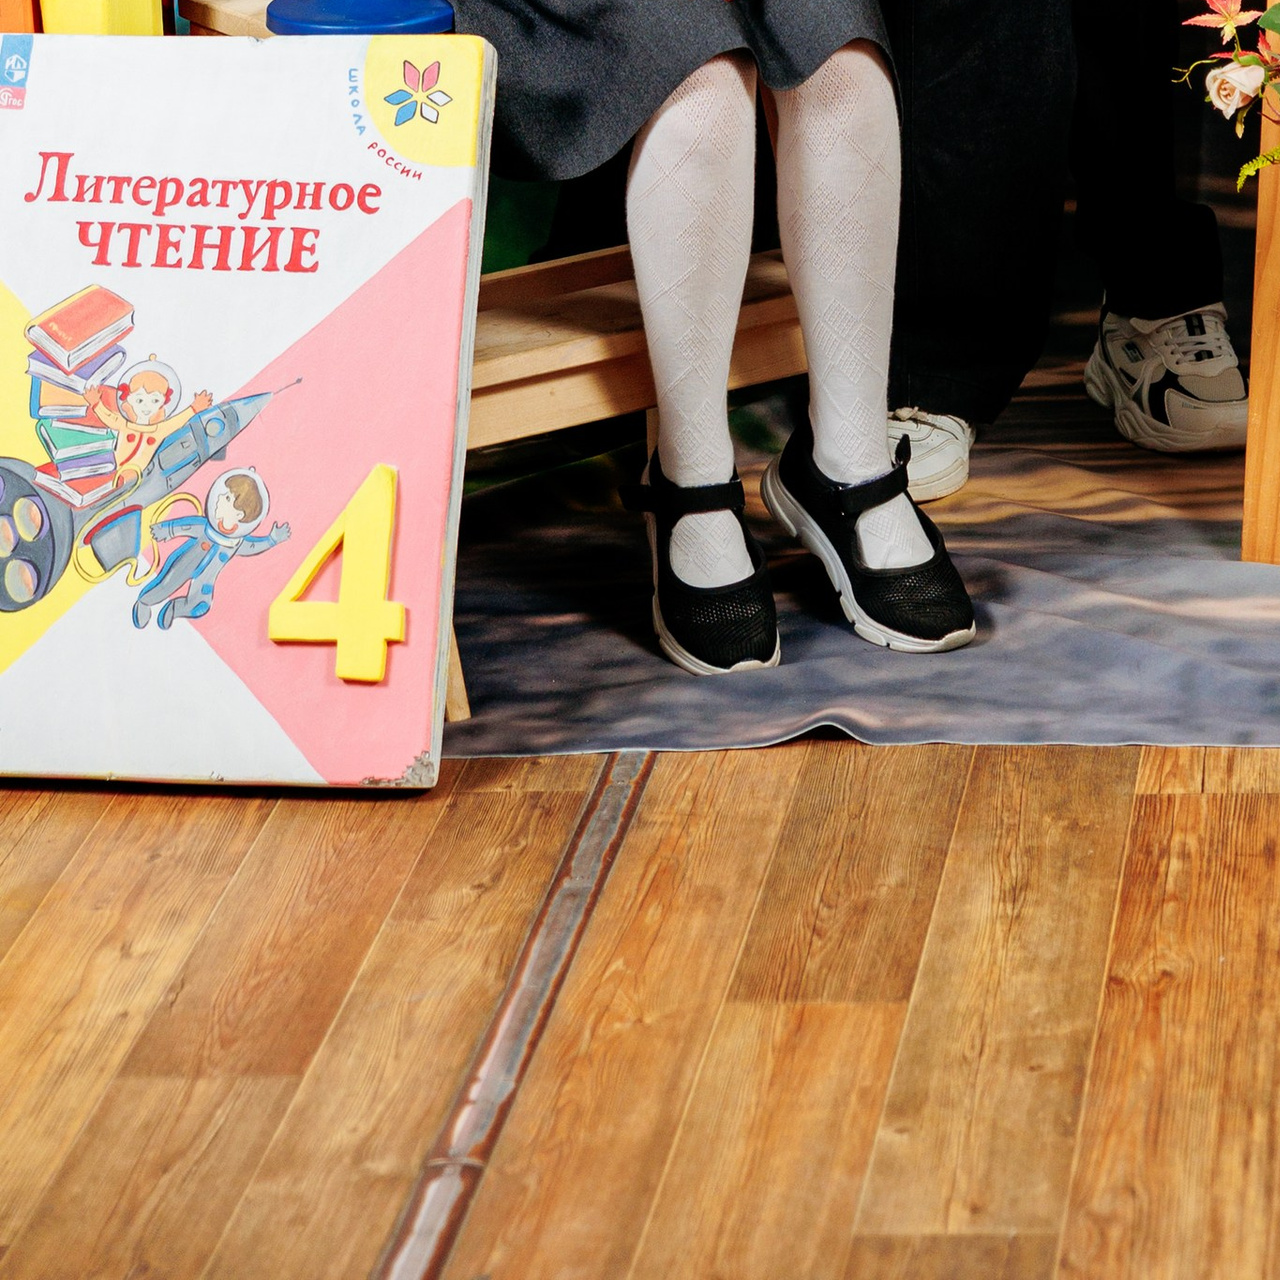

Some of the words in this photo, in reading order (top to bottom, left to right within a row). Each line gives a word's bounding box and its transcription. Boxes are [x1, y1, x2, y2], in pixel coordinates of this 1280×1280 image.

[24, 151, 382, 220] Литературное
[76, 221, 320, 273] ЧТЕНИЕ
[267, 463, 405, 683] 4
